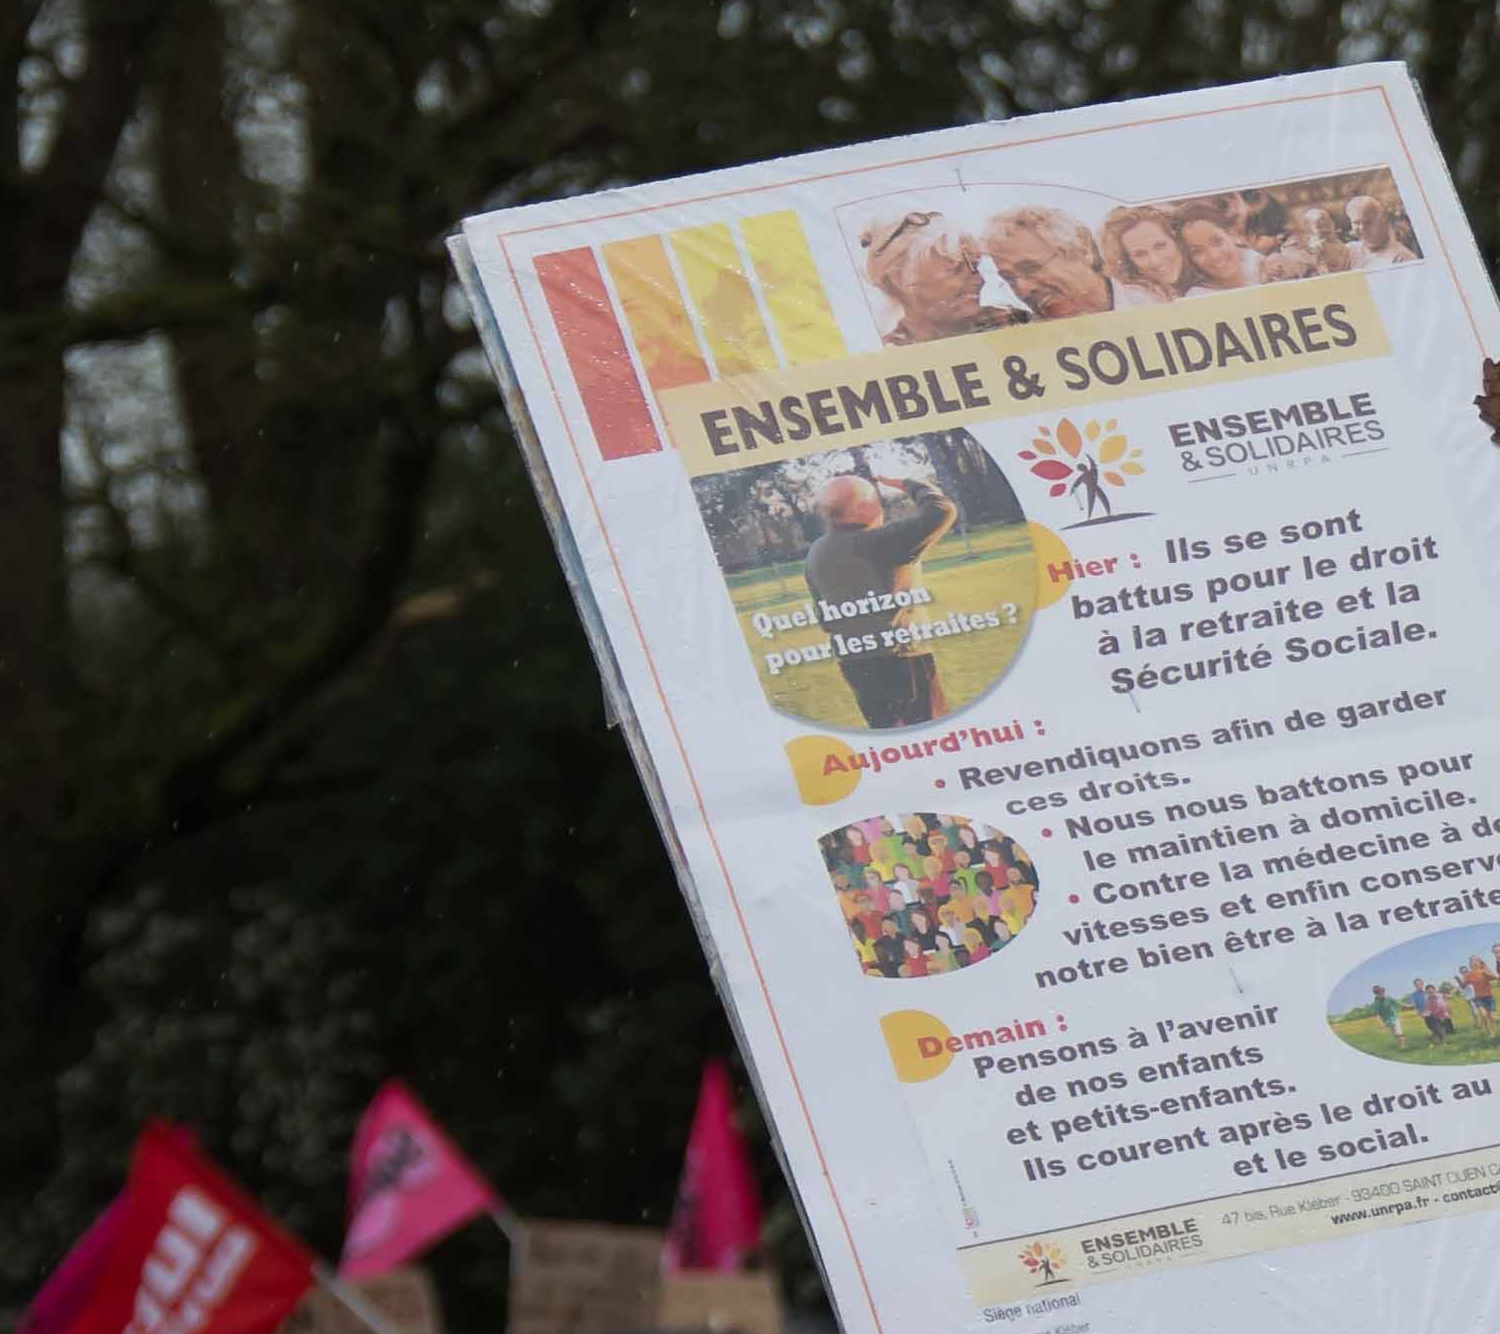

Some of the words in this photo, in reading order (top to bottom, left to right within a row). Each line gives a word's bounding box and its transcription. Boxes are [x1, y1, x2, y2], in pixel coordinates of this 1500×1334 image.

[699, 361, 991, 457] ENSEMBLE
[1002, 354, 1046, 401] &
[1055, 303, 1357, 391] SOLIDAIRES
[1167, 391, 1377, 448] ENSEMBLE
[1180, 450, 1204, 472] &
[1204, 419, 1385, 468] SOLIDAIRES
[1046, 556, 1118, 584] Hier
[1165, 536, 1211, 564] Ils
[1223, 530, 1268, 554] se
[1279, 508, 1363, 544] sont
[1070, 582, 1194, 620] battus
[1205, 564, 1291, 604] pour
[1302, 554, 1337, 580] le
[1348, 535, 1439, 572] droit
[750, 602, 819, 639] Quel
[817, 580, 932, 622] horizon
[762, 638, 835, 676] pour
[834, 628, 878, 655] les
[878, 605, 1001, 648] retraites
[1097, 629, 1120, 656] à
[1131, 624, 1168, 650] la
[1179, 598, 1324, 642] retraite
[1335, 585, 1375, 614] et
[1385, 580, 1421, 606] la
[1110, 642, 1272, 694] Sécurité
[1284, 619, 1437, 663] Sociale.
[957, 733, 1202, 791] Revendiquons
[1211, 717, 1275, 745] afin
[1283, 708, 1326, 732] de
[1336, 688, 1447, 729] garder
[1005, 791, 1069, 816] ces
[1078, 770, 1191, 802] droits.
[1064, 809, 1156, 839] Nous
[1164, 793, 1248, 822] nous
[1255, 768, 1389, 806] battons
[1397, 752, 1473, 787] pour
[1082, 849, 1117, 872] le
[1126, 822, 1279, 864] maintien
[1288, 812, 1311, 835] à
[1319, 787, 1477, 830] domicile.
[1092, 870, 1211, 905] Contre
[1218, 860, 1254, 883] la
[1261, 831, 1430, 875] médecine
[1440, 821, 1463, 844] à
[1061, 906, 1210, 946] vitesses
[1219, 892, 1257, 918] et
[1265, 878, 1350, 910] enfin
[1034, 956, 1129, 988] notre
[1136, 941, 1214, 969] bien
[1223, 926, 1295, 954] être
[1305, 915, 1328, 939] à
[1334, 911, 1370, 933] la
[916, 1018, 1047, 1060] Demain
[972, 1036, 1118, 1079] Pensons
[1126, 1026, 1149, 1049] à
[1015, 1082, 1057, 1107] de
[1065, 1071, 1128, 1098] nos
[1137, 1044, 1264, 1083] enfants
[1006, 1119, 1043, 1145] et
[1050, 1077, 1297, 1143] petits-enfants.
[1022, 1156, 1067, 1182] Ils
[1076, 1125, 1210, 1171] courent
[1217, 1111, 1313, 1146] après
[1319, 1102, 1353, 1125] le
[1362, 1082, 1443, 1117] droit
[1451, 1078, 1493, 1100] au
[1232, 1152, 1269, 1177] et
[1273, 1147, 1307, 1170] le
[1316, 1122, 1429, 1162] social.
[1218, 1210, 1242, 1227] 47
[1268, 1200, 1295, 1217] Rue
[1350, 1181, 1400, 1202] 93400
[1402, 1172, 1444, 1192] SAINT
[1445, 1164, 1487, 1184] OUEN
[1330, 1195, 1430, 1225] www.unrpa.fr
[1080, 1217, 1199, 1255] ENSEMBLE
[1086, 1254, 1101, 1269] &
[1100, 1233, 1204, 1266] SOLIDAIRES
[982, 1305, 1022, 1323] Siège
[1025, 1292, 1082, 1315] national
